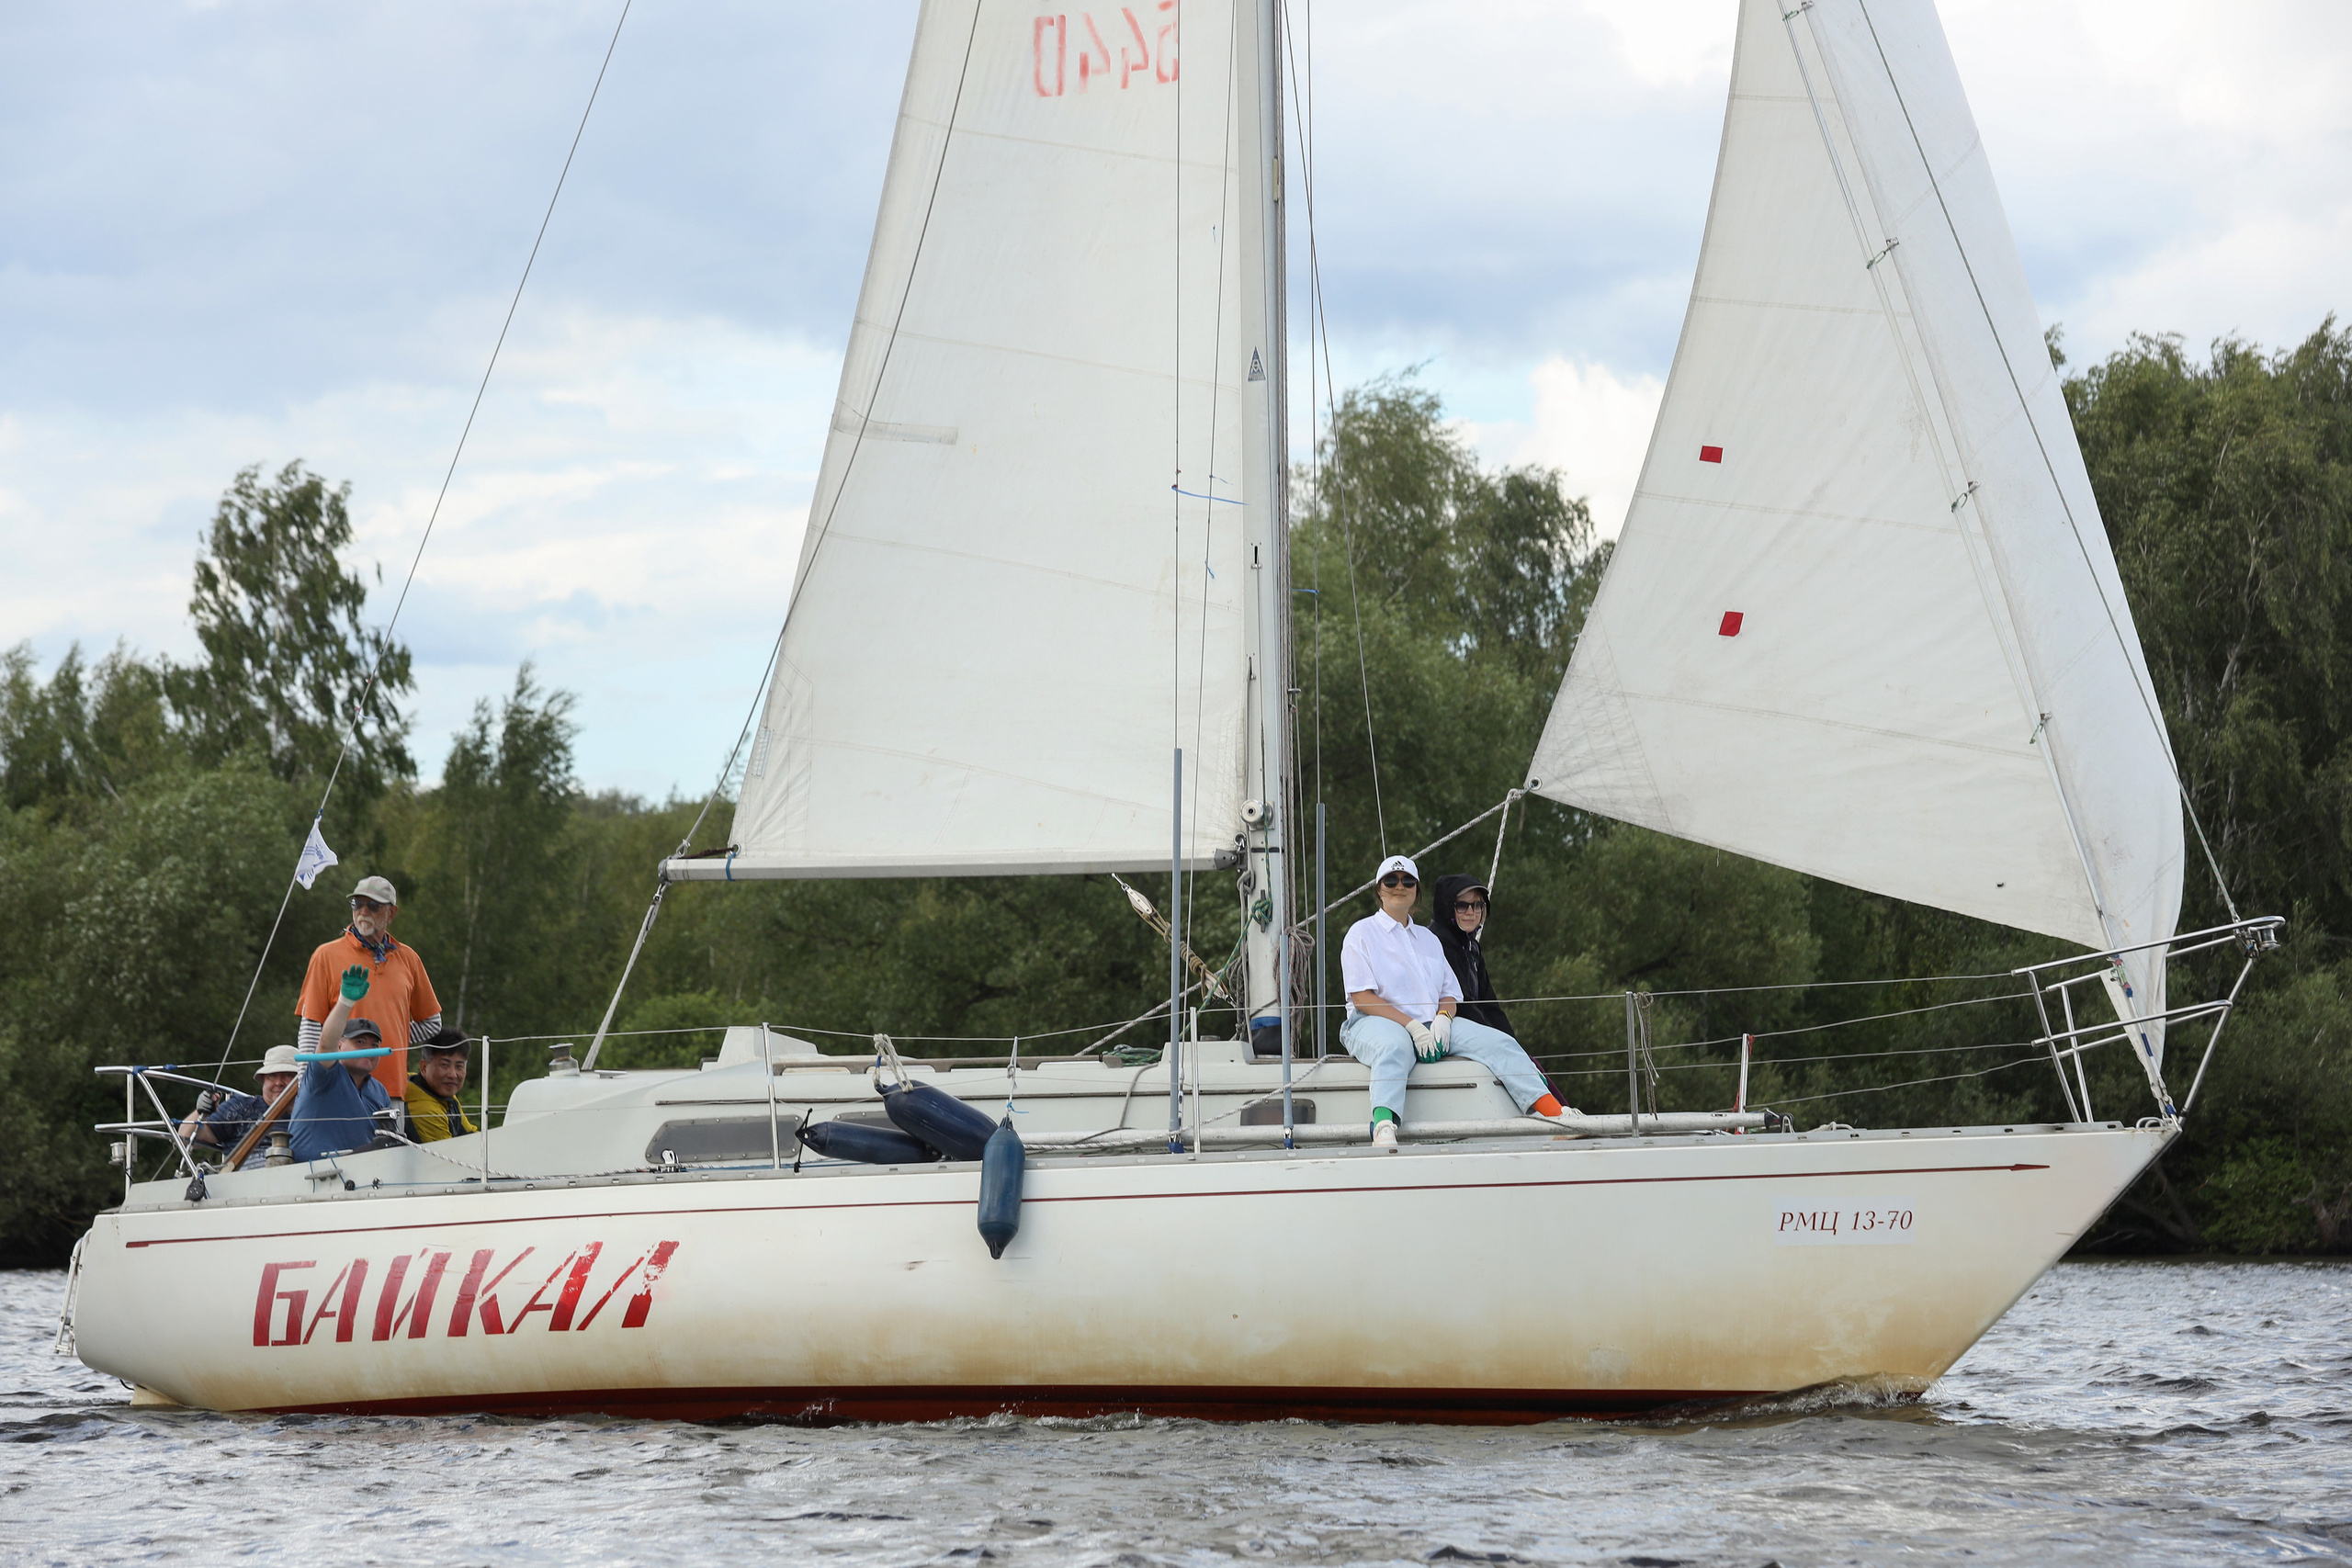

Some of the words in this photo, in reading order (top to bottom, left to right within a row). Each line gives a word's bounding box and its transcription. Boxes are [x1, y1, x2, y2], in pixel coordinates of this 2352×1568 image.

[1778, 1211, 1840, 1235] РМЦ
[1851, 1210, 1913, 1231] 13-70
[253, 1240, 680, 1347] БАЙКАЛ
